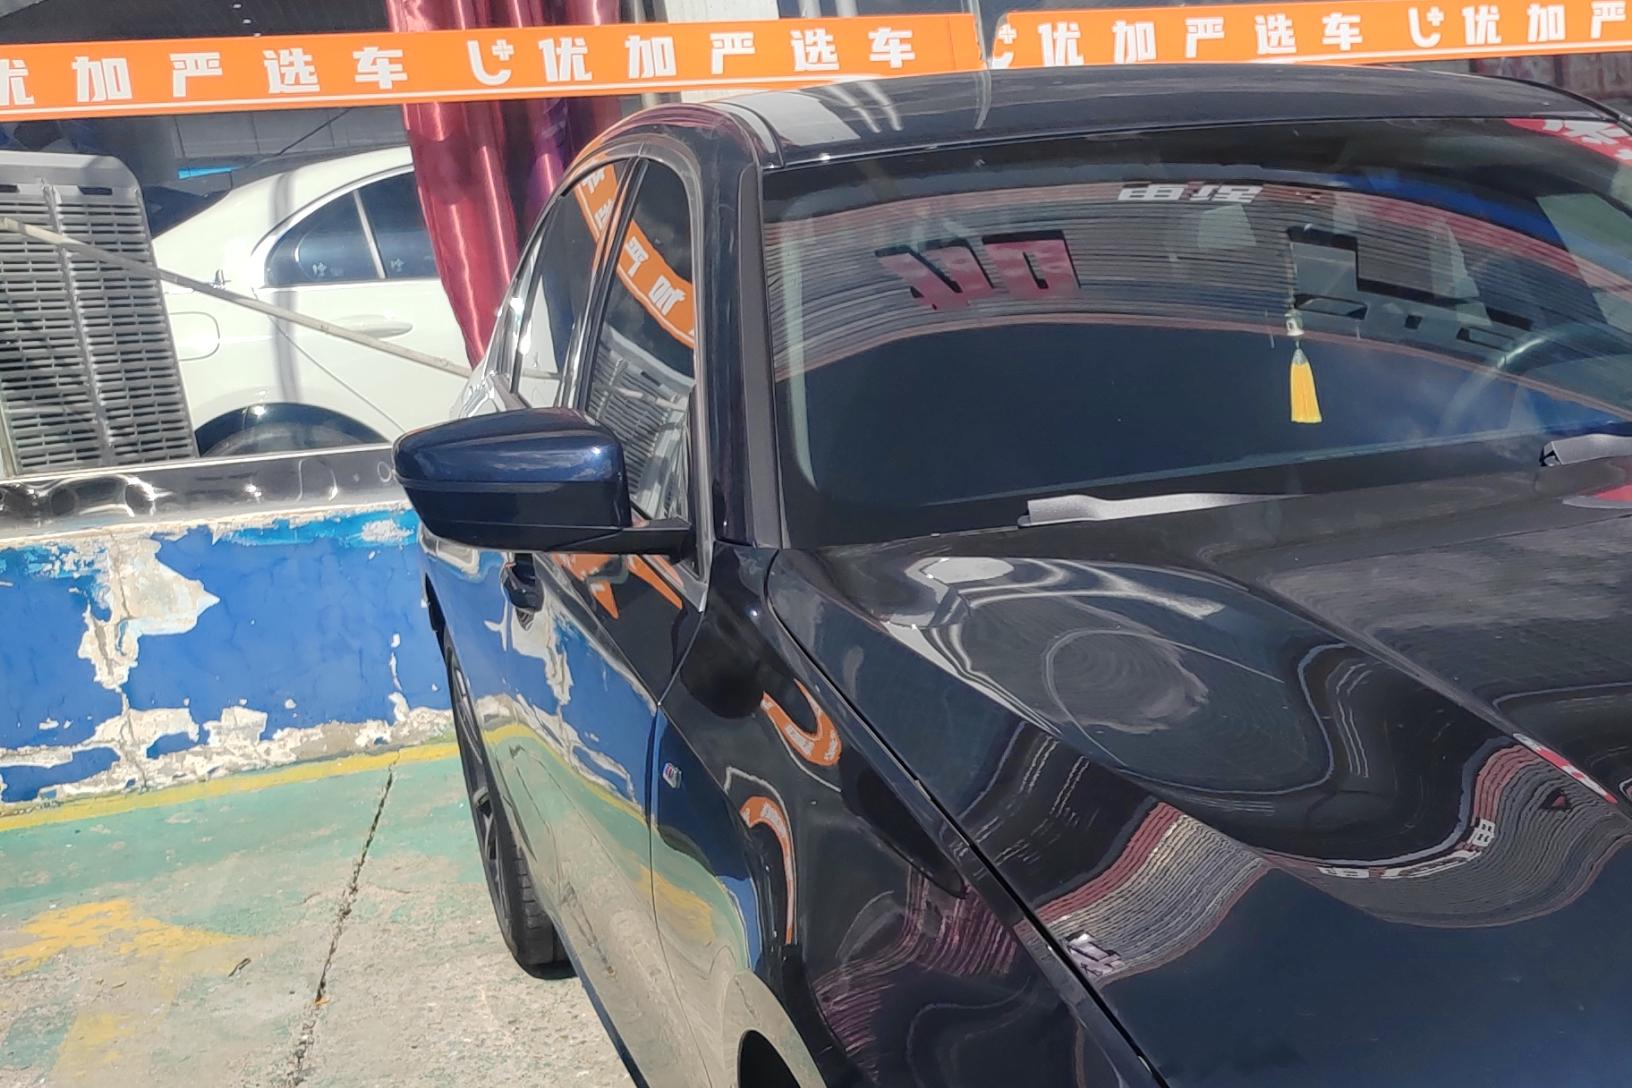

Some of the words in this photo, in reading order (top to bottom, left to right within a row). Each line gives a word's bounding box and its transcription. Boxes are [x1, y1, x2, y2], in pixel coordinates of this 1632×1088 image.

[538, 27, 916, 83] 优加严选车
[1037, 12, 1363, 66] 优加严选车
